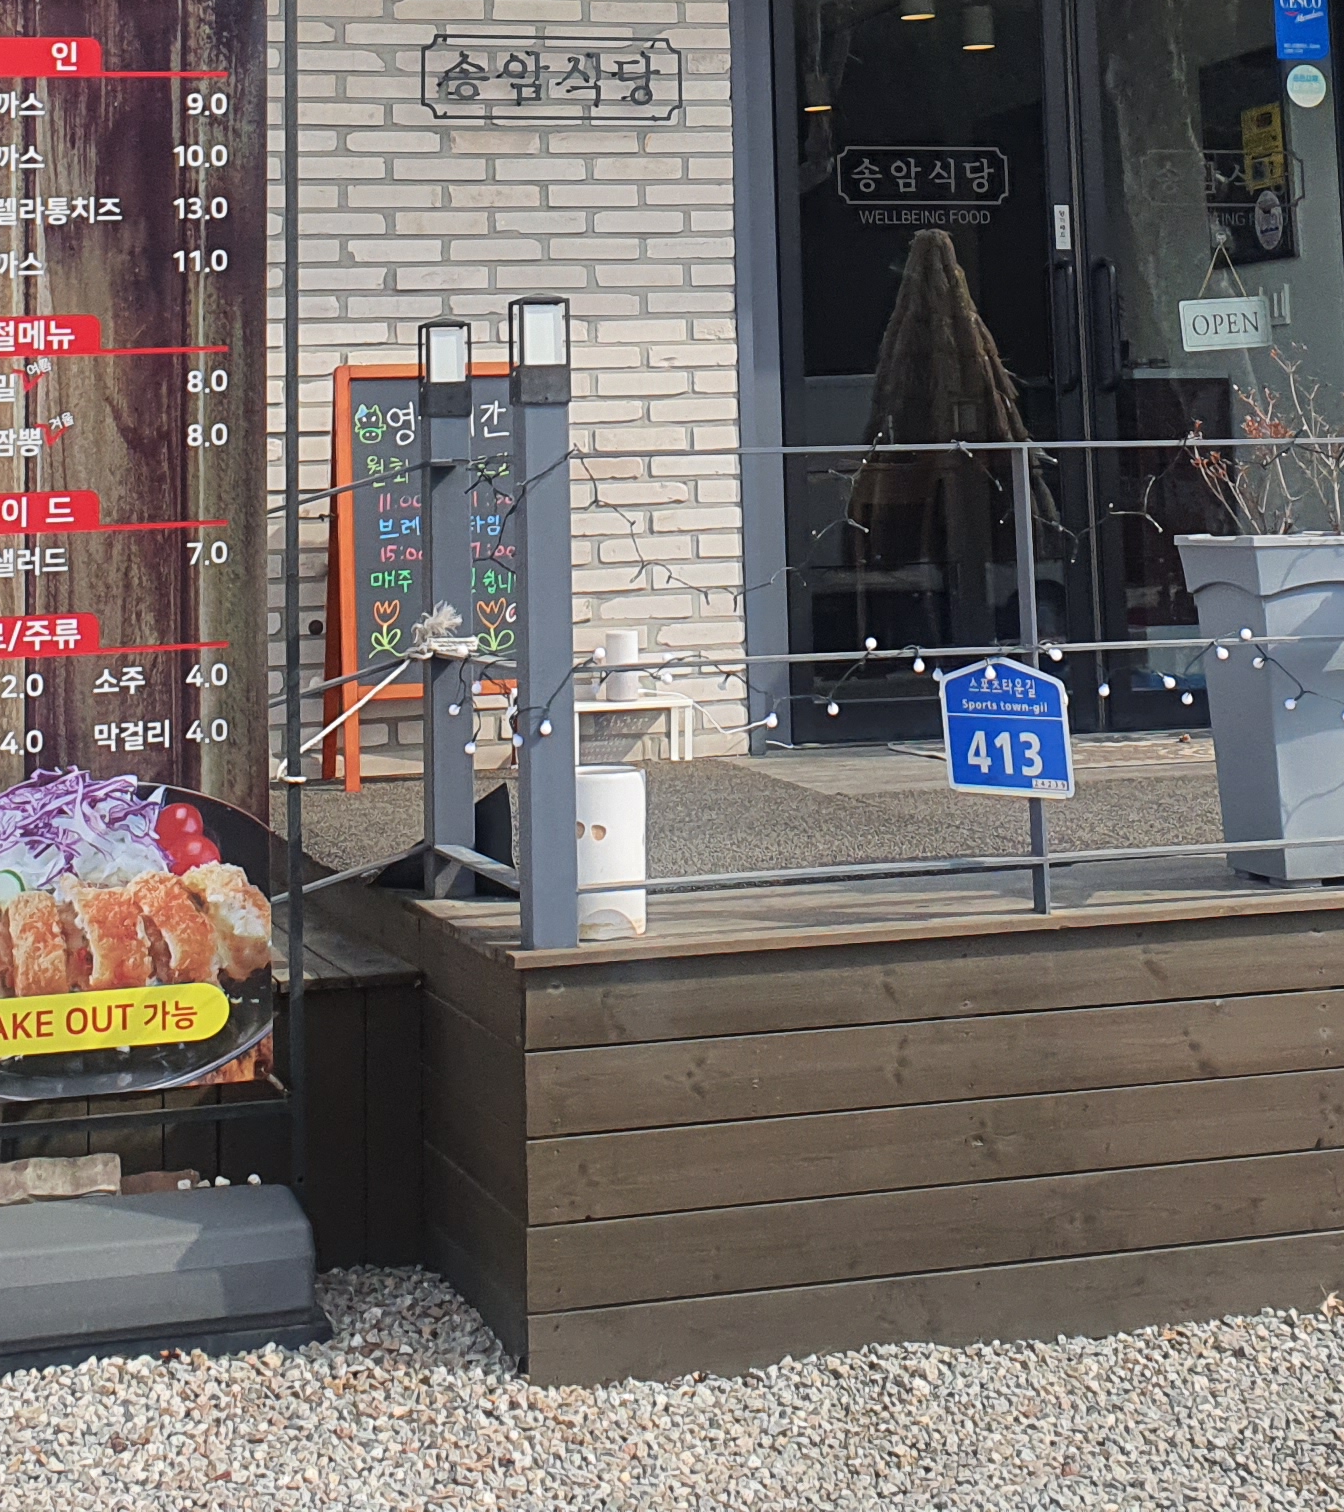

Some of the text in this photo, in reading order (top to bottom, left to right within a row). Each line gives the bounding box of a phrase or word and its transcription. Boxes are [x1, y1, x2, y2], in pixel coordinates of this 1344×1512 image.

[436, 50, 661, 108] 송암식당
[187, 93, 227, 116] 9.0
[173, 144, 228, 168] 10.0
[851, 157, 995, 194] 송암식당
[173, 197, 228, 220] 13.0
[859, 209, 992, 225] WELLBEING FOOD
[173, 249, 228, 273] 11.0
[1191, 310, 1261, 338] OPEN
[187, 369, 228, 393] 8.0
[187, 423, 228, 447] 8.0
[186, 541, 228, 566] 7.0
[482, 568, 517, 594] 쉽니
[1, 673, 43, 699] 2.0
[93, 663, 228, 695] 소주 4.0
[968, 676, 1037, 698] 스포츠타운길
[962, 698, 1048, 714] Sports town-gil
[0, 730, 43, 755] 4.0
[94, 719, 228, 752] 막걸리 4.0
[967, 730, 1044, 777] 413
[65, 1003, 135, 1035] OUT
[143, 1000, 198, 1031] 가능
